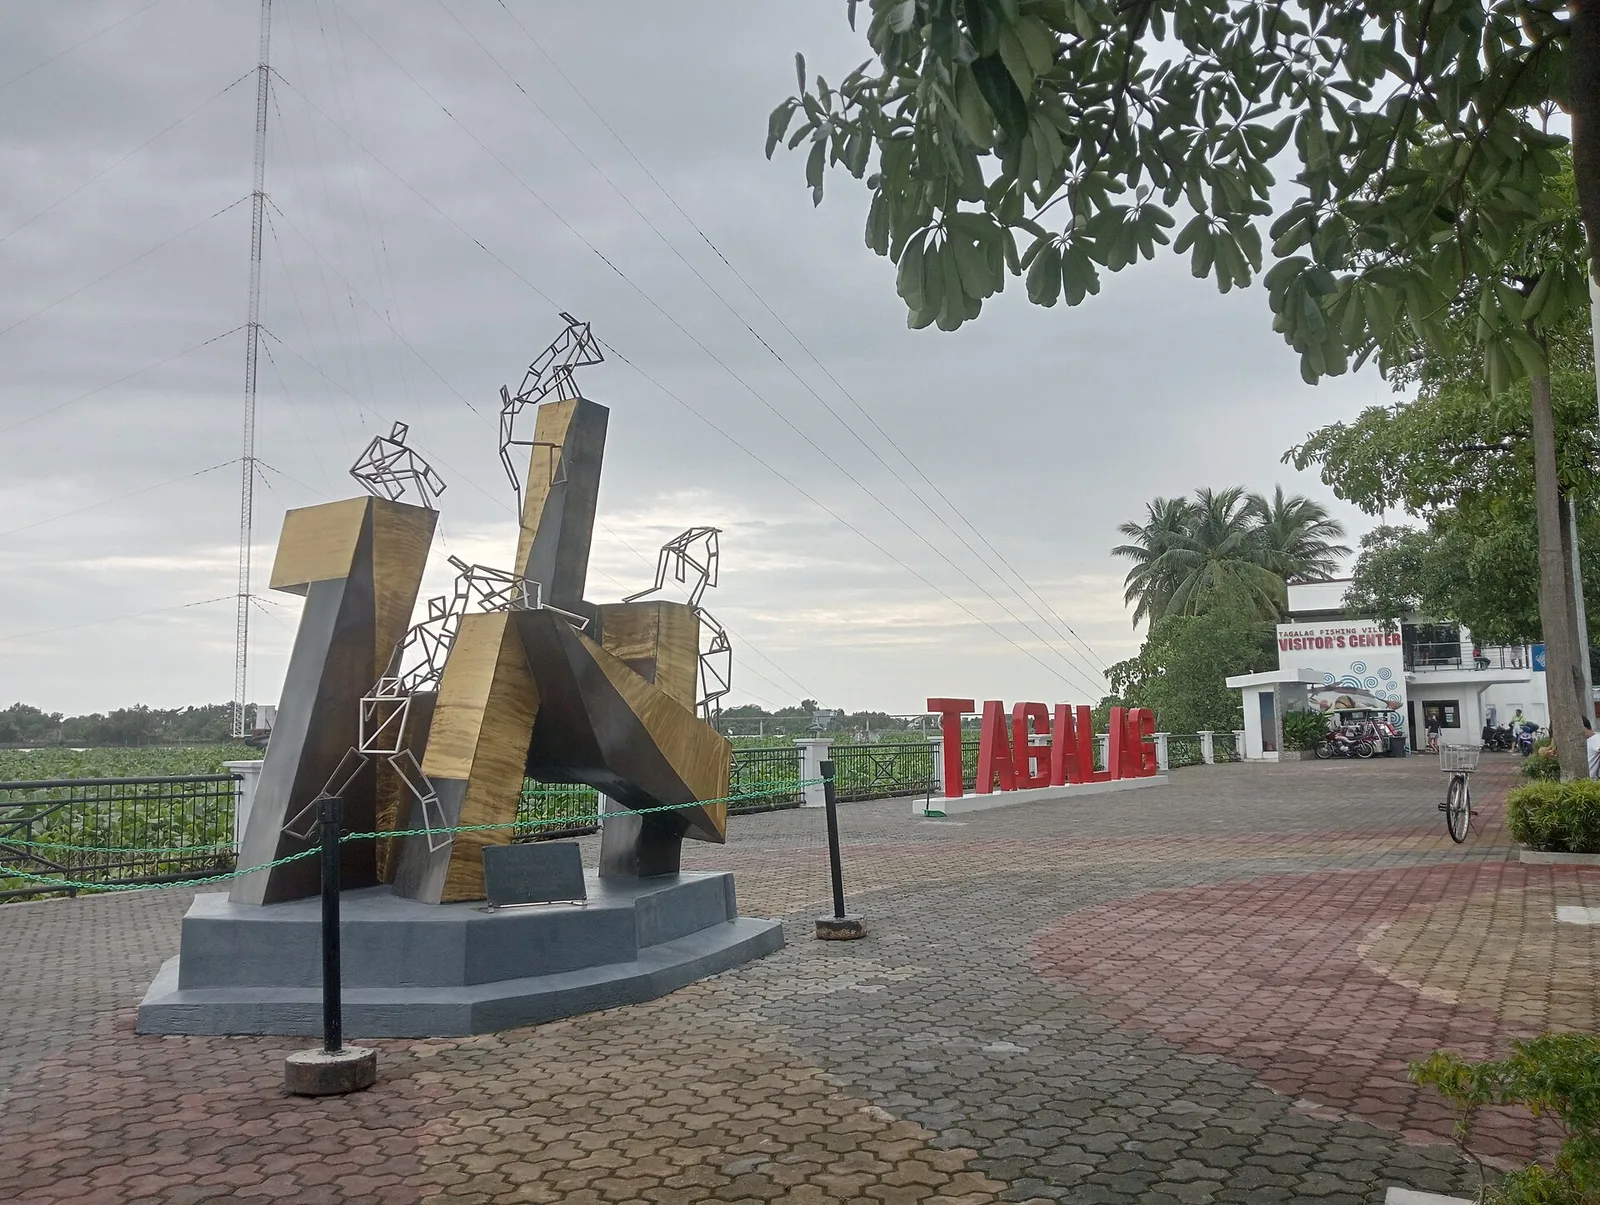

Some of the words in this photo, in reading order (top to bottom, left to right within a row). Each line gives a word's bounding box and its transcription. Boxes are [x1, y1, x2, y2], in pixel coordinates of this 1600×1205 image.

[1279, 635, 1346, 651] VISITOR'S
[1349, 633, 1402, 648] CENTER
[927, 698, 1157, 798] TAGALAG
